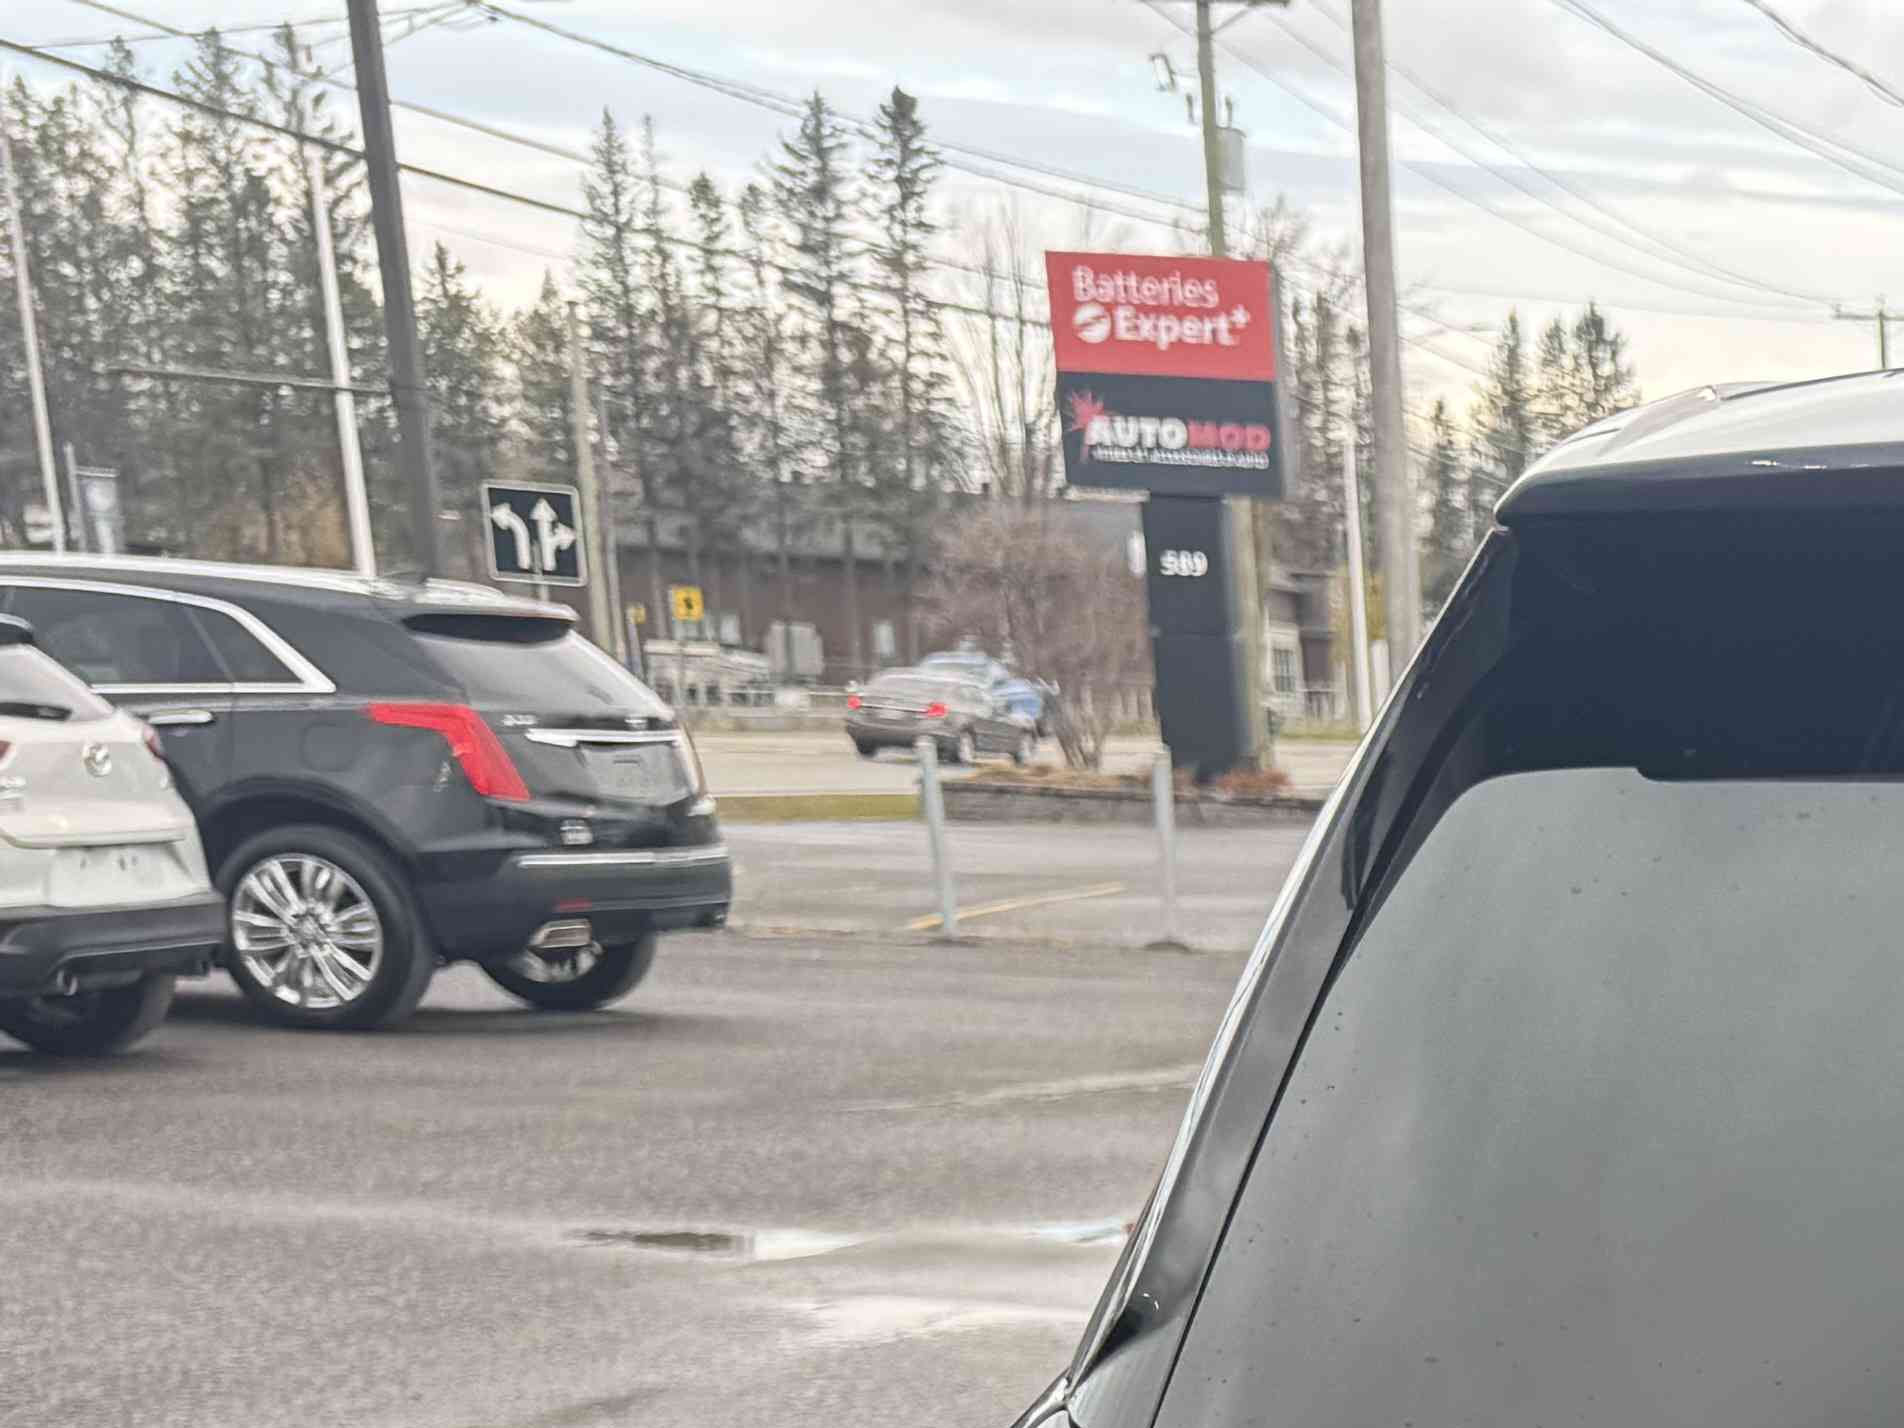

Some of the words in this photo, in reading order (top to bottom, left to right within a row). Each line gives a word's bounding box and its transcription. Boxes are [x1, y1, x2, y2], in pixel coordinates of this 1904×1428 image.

[1071, 264, 1219, 308] Batteries
[1114, 304, 1241, 351] Expert
[1085, 415, 1271, 452] AUTOMOD
